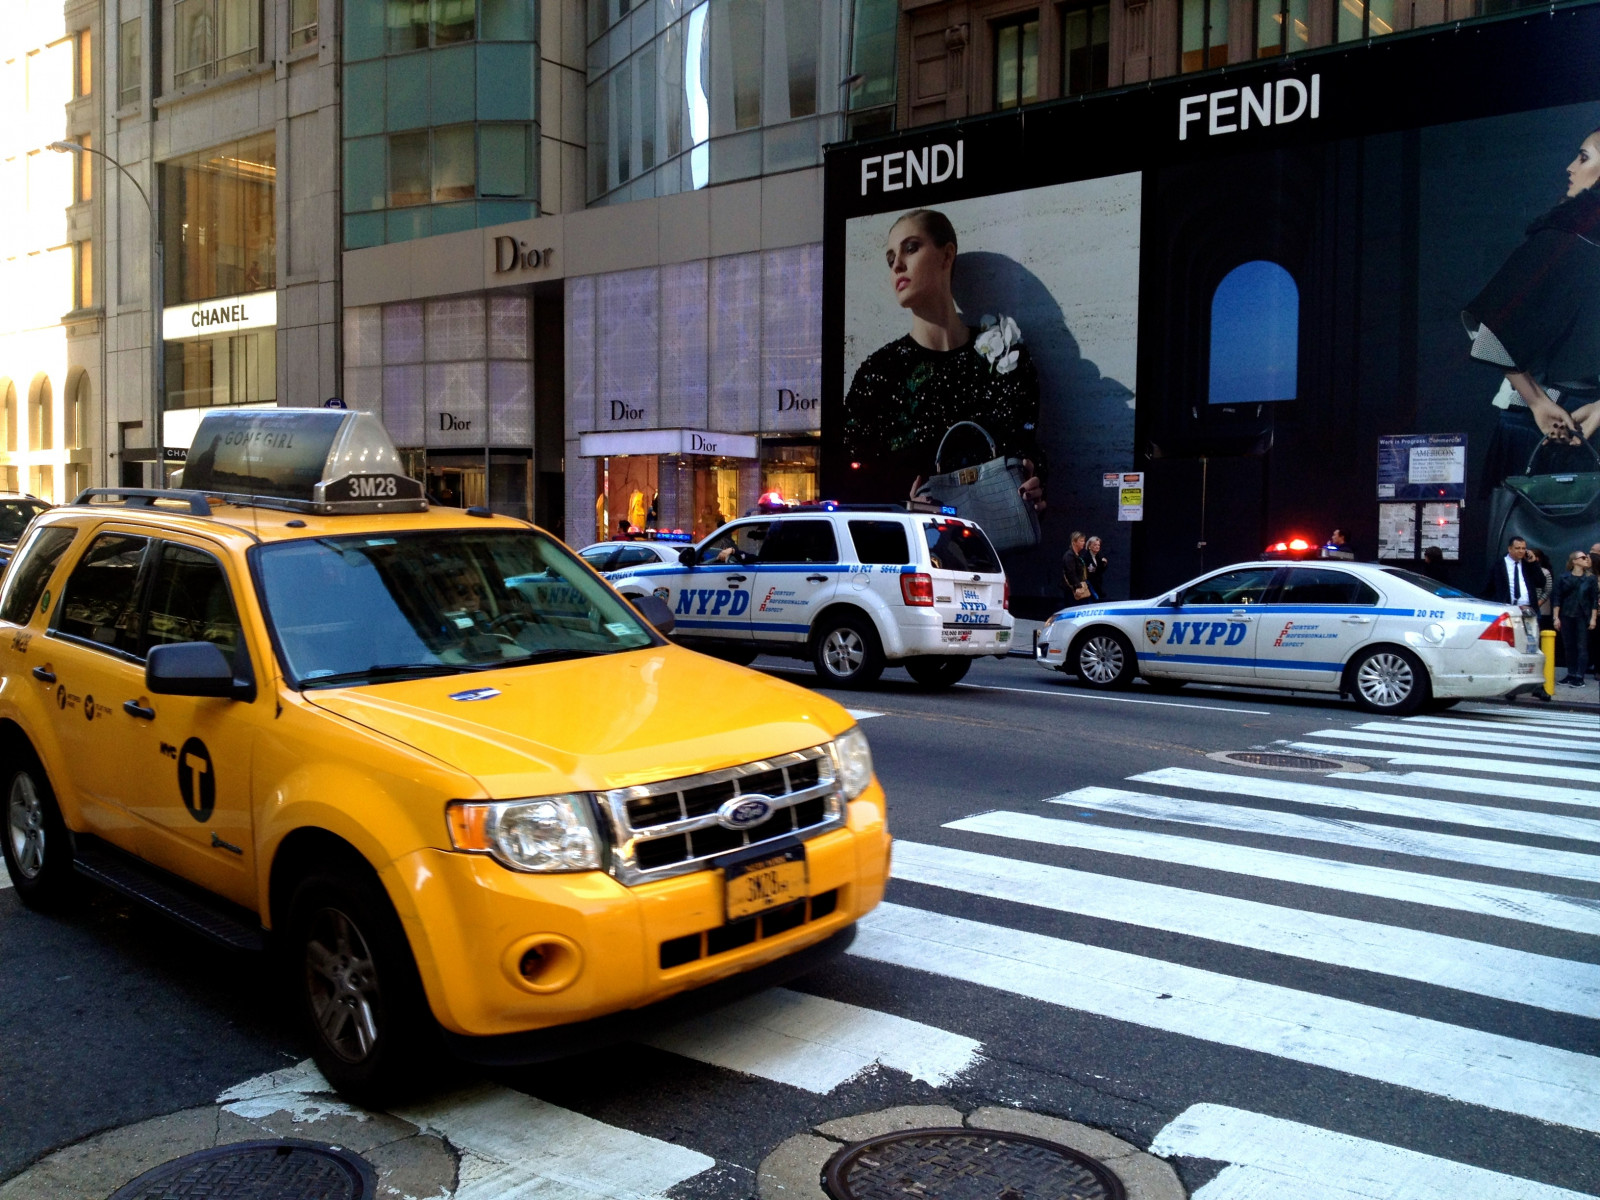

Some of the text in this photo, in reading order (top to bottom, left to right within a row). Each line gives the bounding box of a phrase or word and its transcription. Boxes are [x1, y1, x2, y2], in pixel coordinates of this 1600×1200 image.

[1178, 73, 1321, 141] FENDI
[861, 140, 964, 196] FENDI
[493, 235, 554, 274] Dior
[191, 304, 249, 328] CHANEL
[610, 400, 645, 422] Dior
[777, 388, 818, 413] Dior
[439, 412, 471, 432] Dior
[224, 431, 295, 449] GONE GIRL
[690, 433, 718, 454] Dior
[167, 449, 187, 457] CHA
[348, 476, 397, 498] 3M28
[860, 564, 873, 574] PCT
[675, 588, 750, 617] NYPD
[960, 602, 987, 611] NYPD
[1076, 609, 1105, 618] POLICE
[955, 613, 990, 623] POLICE
[1417, 609, 1445, 619] 20 PCT
[1166, 621, 1247, 646] NYPD
[185, 752, 207, 811] T
